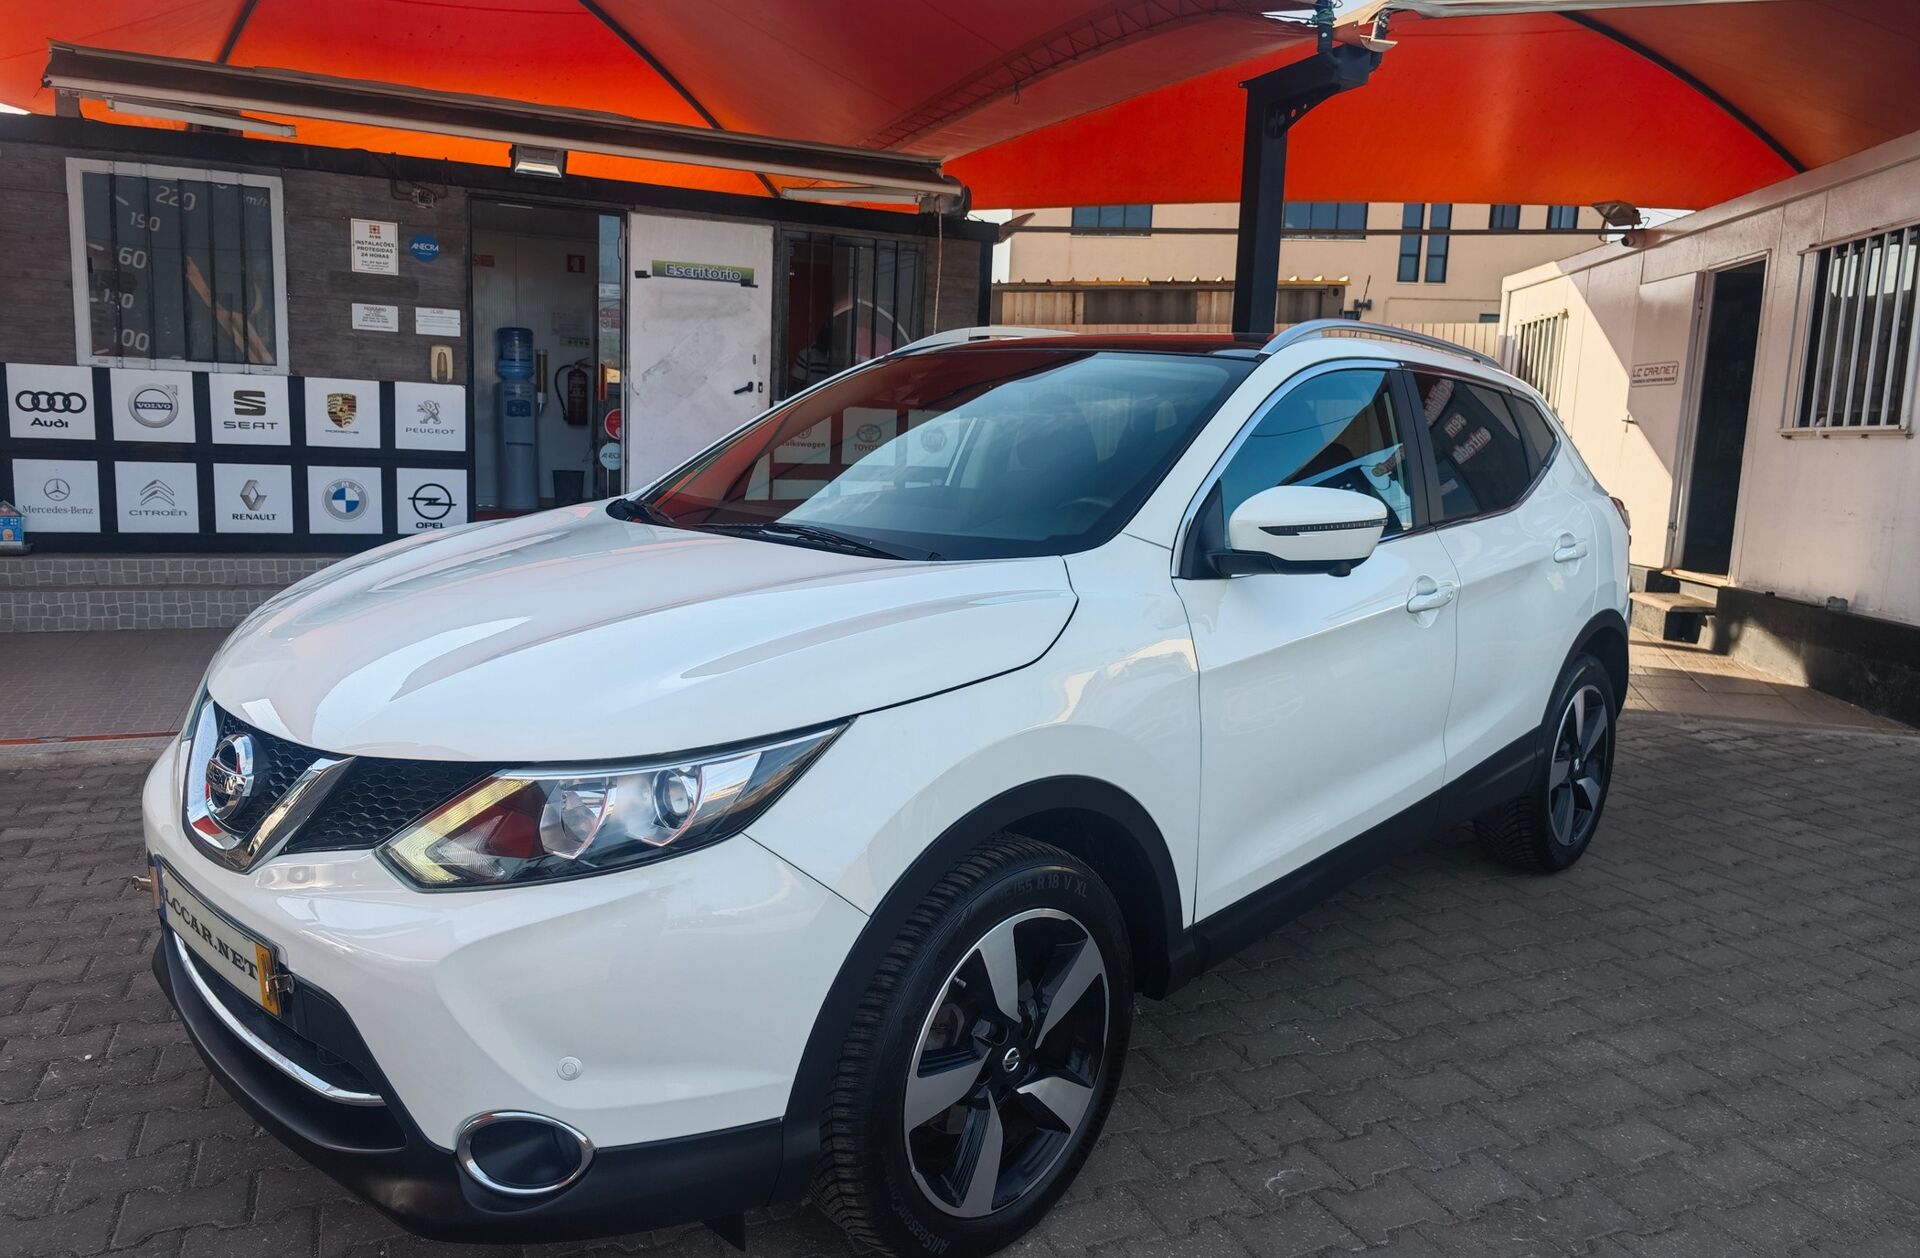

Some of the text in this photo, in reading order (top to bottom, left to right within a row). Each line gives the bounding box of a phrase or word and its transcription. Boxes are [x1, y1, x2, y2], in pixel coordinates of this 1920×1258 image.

[155, 185, 196, 211] 220
[356, 246, 393, 254] PROTEGIDAS
[411, 242, 440, 252] ANECRA
[117, 247, 147, 269] 60
[665, 263, 742, 281] Escritório
[136, 401, 172, 410] VOLVO
[30, 417, 69, 428] Audi
[223, 420, 278, 430] SEAT
[405, 427, 456, 435] PEUGEOT
[22, 505, 94, 515] Mercedes-Benz
[232, 513, 277, 521] RENAULT
[415, 522, 446, 530] OPEL
[164, 886, 259, 981] LCCAR.NET
